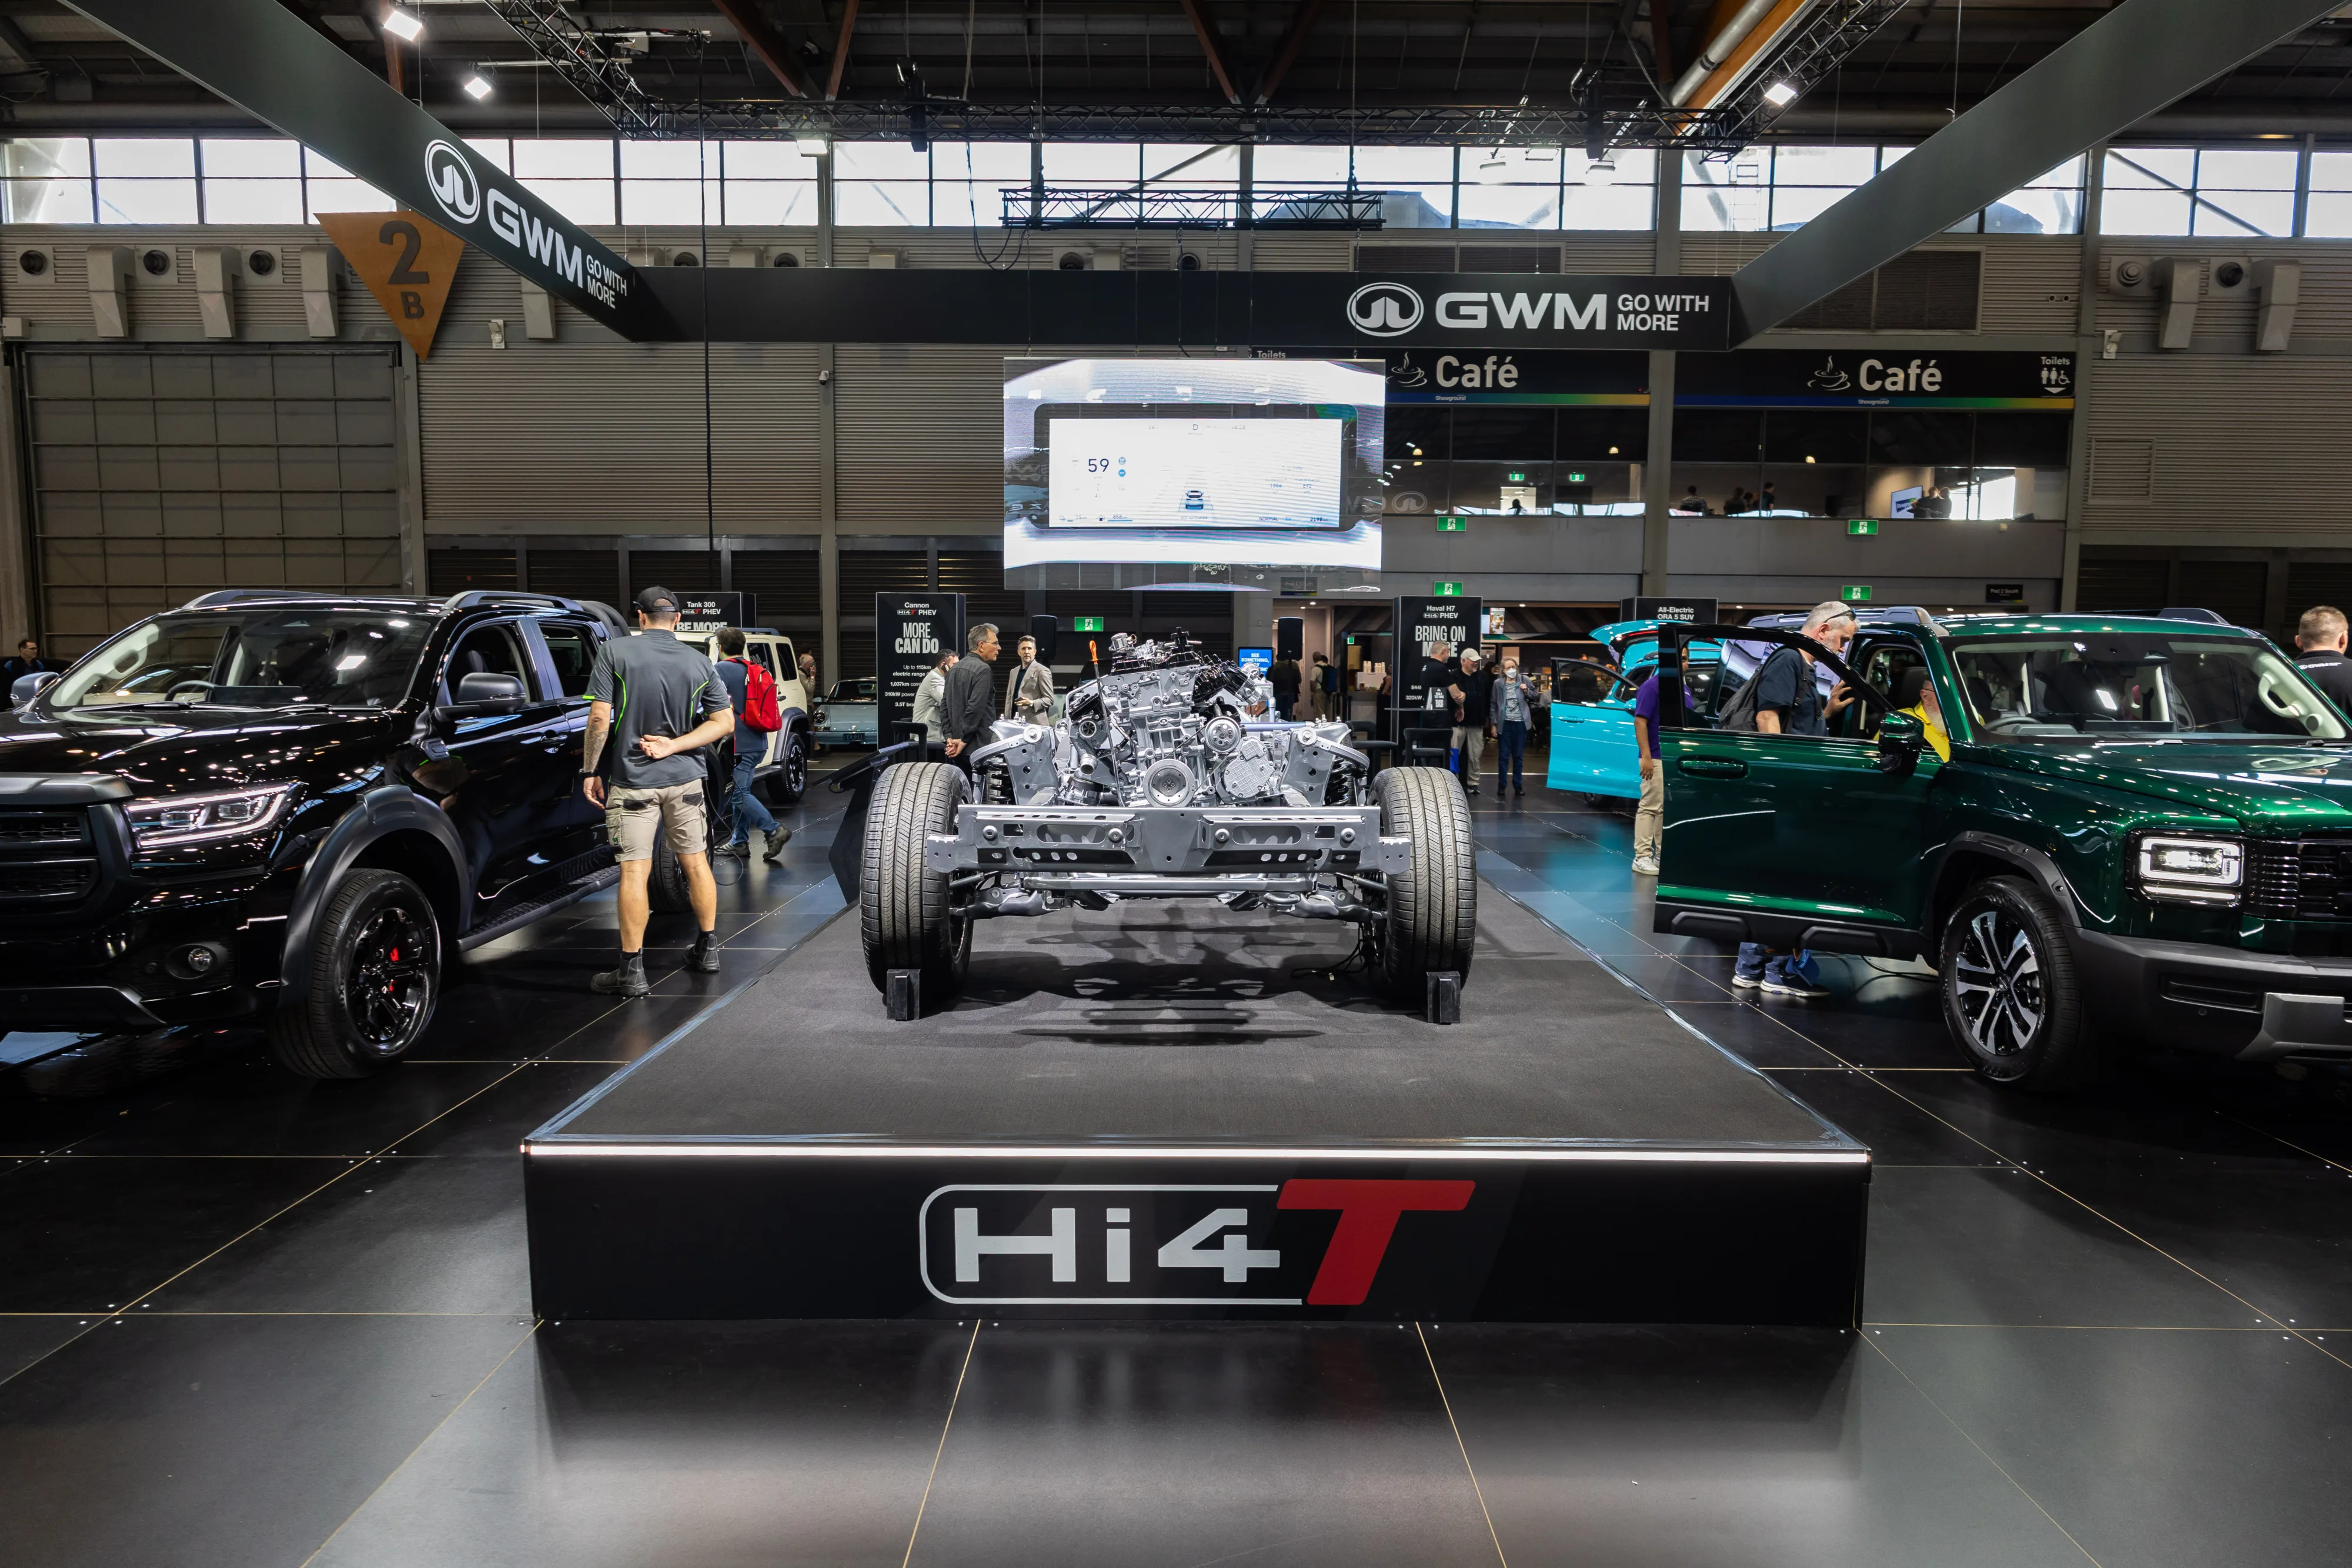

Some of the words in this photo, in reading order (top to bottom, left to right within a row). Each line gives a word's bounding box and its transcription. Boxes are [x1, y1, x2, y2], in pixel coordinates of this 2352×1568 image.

[487, 188, 583, 289] GWM
[379, 220, 430, 284] 2
[587, 255, 602, 274] GO
[603, 264, 627, 297] WITH
[401, 292, 425, 319] B
[587, 280, 616, 310] MORE
[1618, 294, 1650, 312] GO
[1654, 295, 1709, 312] WITH
[1436, 292, 1607, 330] GWM
[1618, 313, 1679, 332] MORE
[1436, 355, 1518, 387] Café
[2040, 356, 2070, 366] Toilets
[1859, 359, 1942, 392] Café
[1088, 459, 1110, 473] 59
[903, 623, 931, 638] MORE
[1415, 626, 1447, 641] BRING
[1451, 626, 1466, 641] ON
[895, 638, 921, 653] CAN
[923, 638, 939, 654] DO
[1422, 641, 1458, 657] ME
